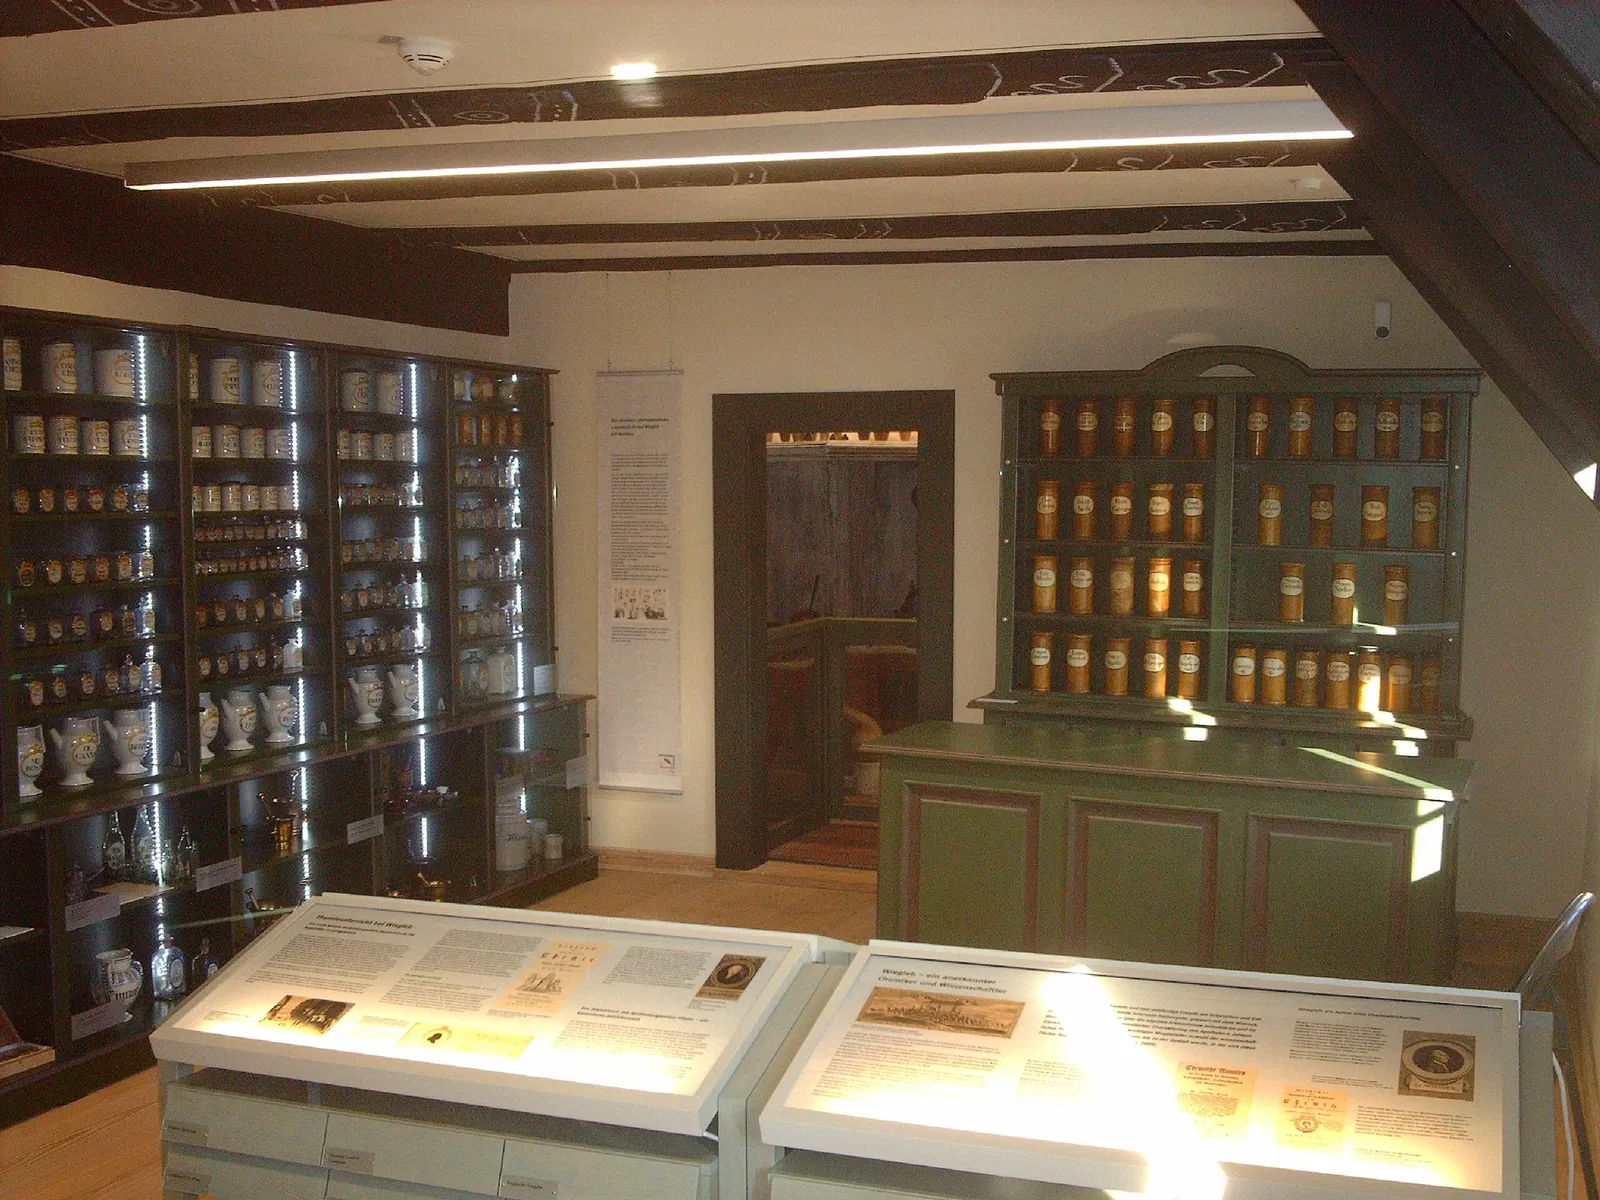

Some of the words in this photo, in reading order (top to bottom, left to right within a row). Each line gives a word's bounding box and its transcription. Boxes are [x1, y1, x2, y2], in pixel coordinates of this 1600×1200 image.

[877, 975, 918, 985] Chemiker
[919, 980, 938, 988] und
[939, 981, 1008, 994] Wissenschaftler
[882, 967, 917, 978] Wiegleb
[941, 974, 998, 985] anerkannter
